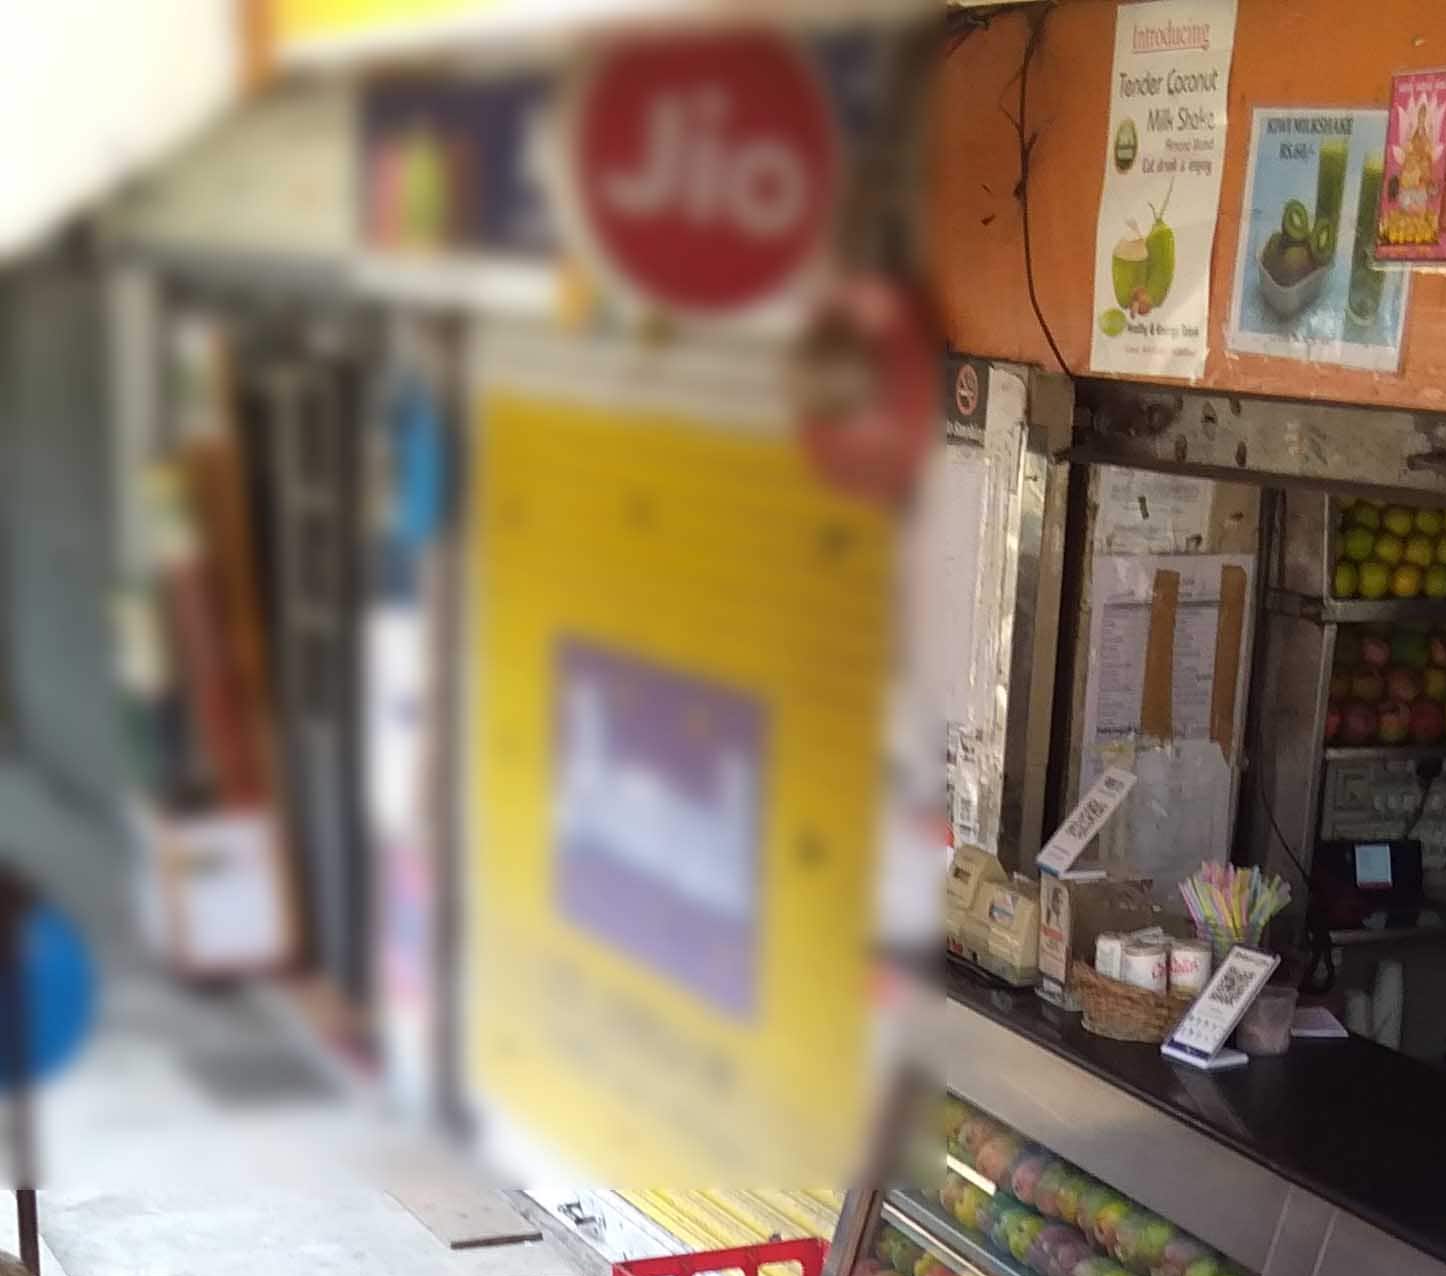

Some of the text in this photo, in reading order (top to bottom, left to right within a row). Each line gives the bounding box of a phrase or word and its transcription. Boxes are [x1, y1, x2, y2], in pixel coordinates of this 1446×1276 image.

[1132, 18, 1210, 51] Introducing
[1120, 68, 1219, 97] Tender Coconut
